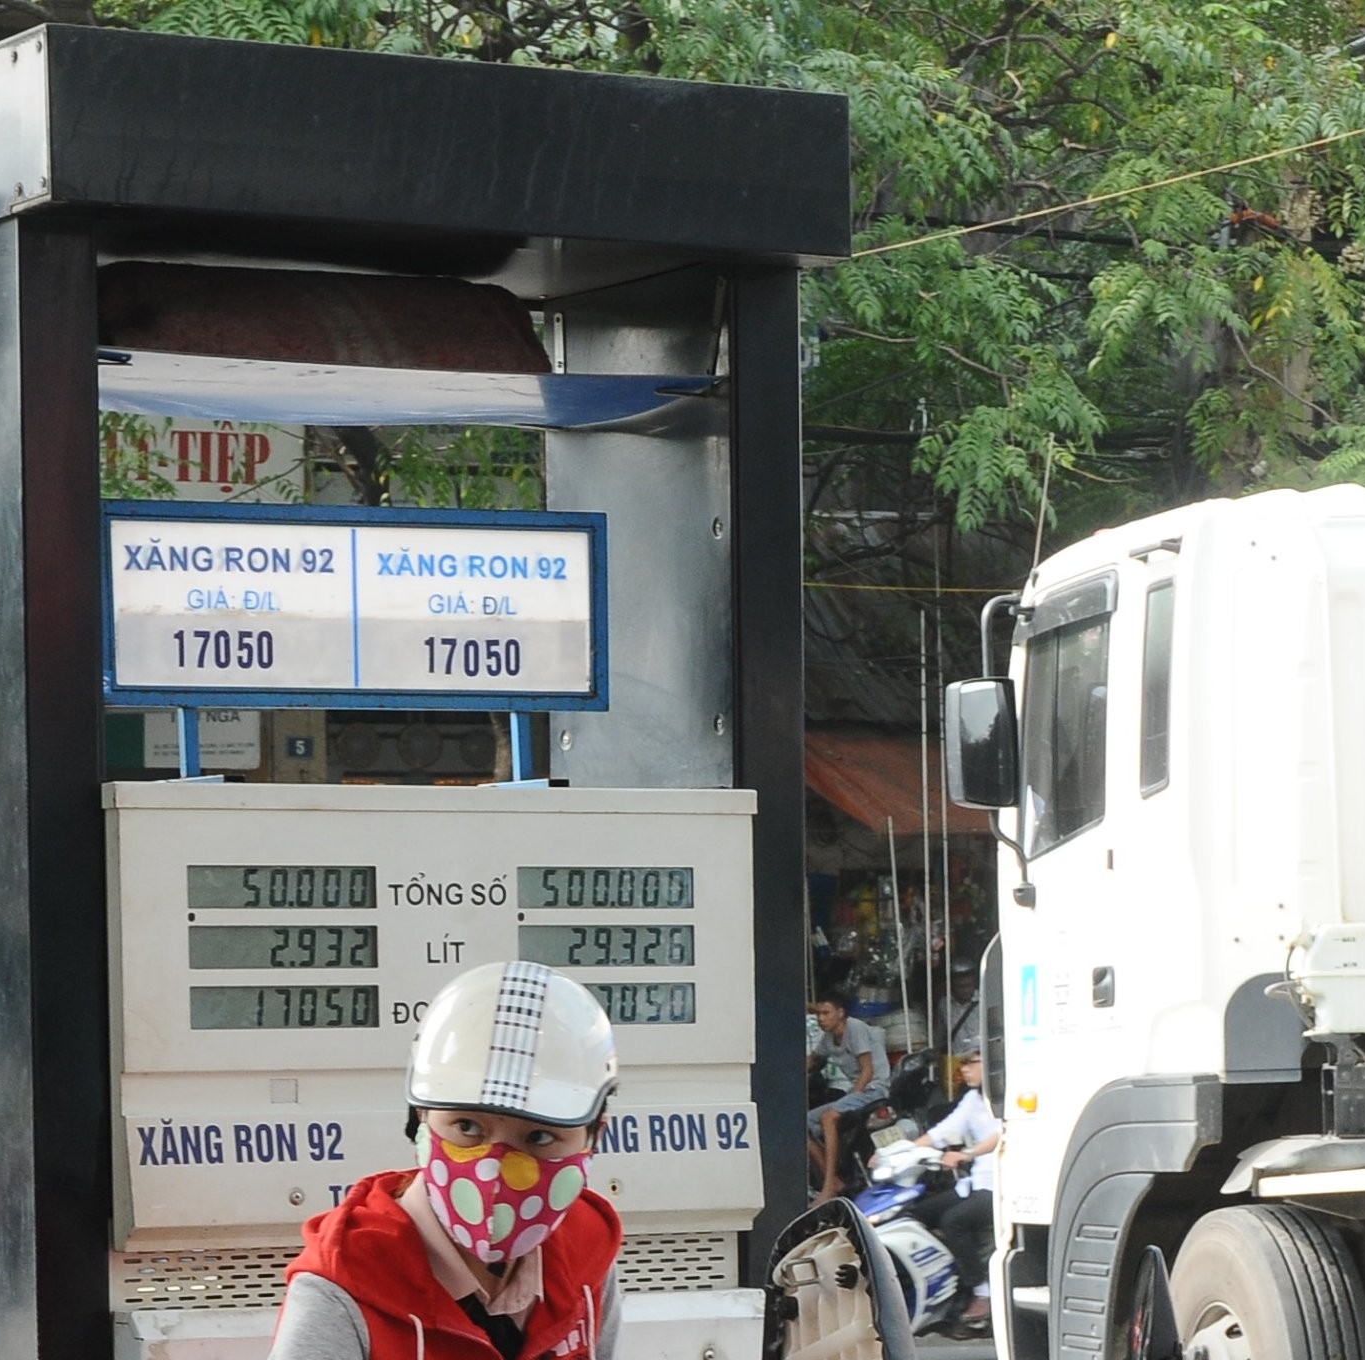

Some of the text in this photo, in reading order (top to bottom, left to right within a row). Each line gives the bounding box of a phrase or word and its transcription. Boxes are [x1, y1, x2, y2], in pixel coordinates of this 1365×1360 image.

[124, 538, 335, 574] XĂNG RON 92
[377, 547, 568, 581] XĂNG RON 92
[173, 629, 274, 670] 17050
[424, 636, 521, 678] 17050
[295, 740, 306, 755] 5
[242, 868, 368, 908] 50.000
[388, 872, 508, 907] TỔNG SỐ
[542, 869, 685, 907] 500.000
[270, 928, 370, 967] 2.932
[426, 932, 466, 964] LÍT
[256, 987, 371, 1027] 17050
[597, 985, 686, 1022] 7050
[137, 1117, 345, 1166] XĂNG RON 92
[593, 1112, 750, 1154] NG RON 92
